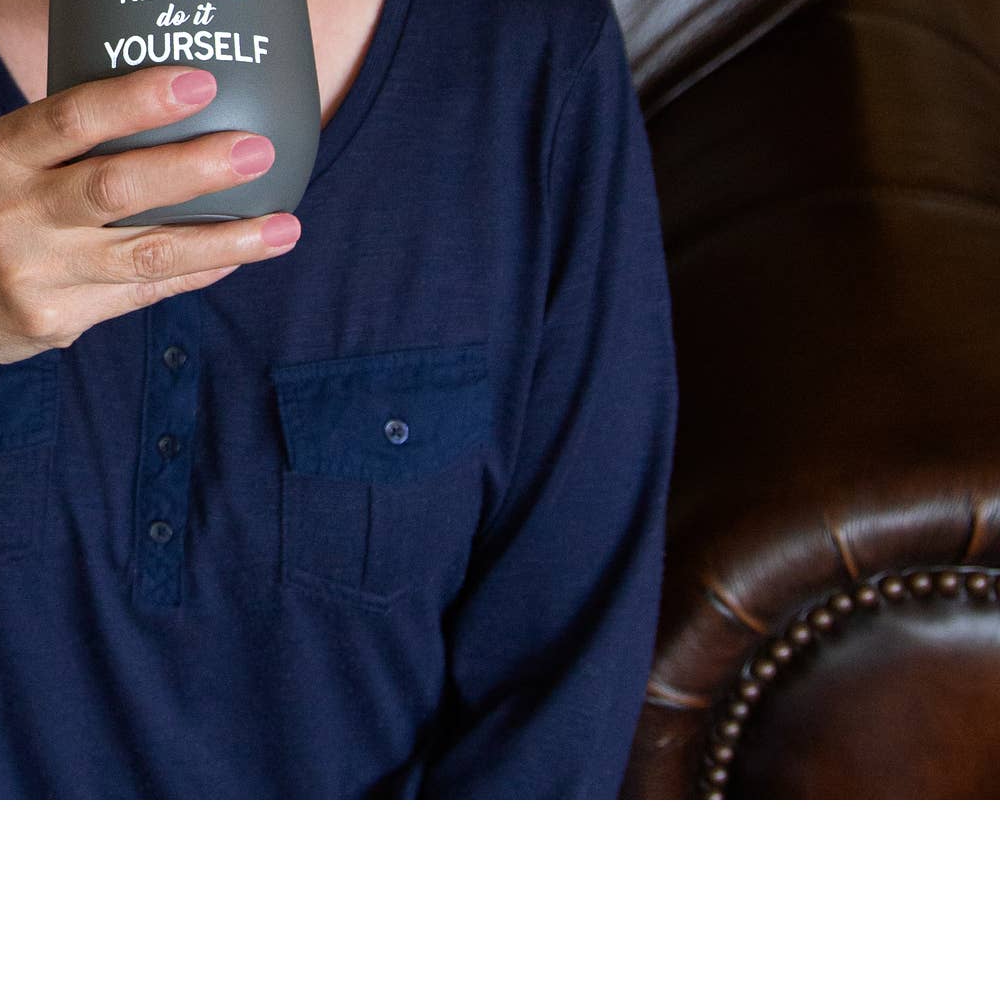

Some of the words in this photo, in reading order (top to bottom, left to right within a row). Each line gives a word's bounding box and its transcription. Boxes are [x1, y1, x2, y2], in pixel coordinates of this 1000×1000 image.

[156, 3, 190, 27] do
[193, 2, 217, 26] it
[104, 30, 269, 69] YOURSELF
